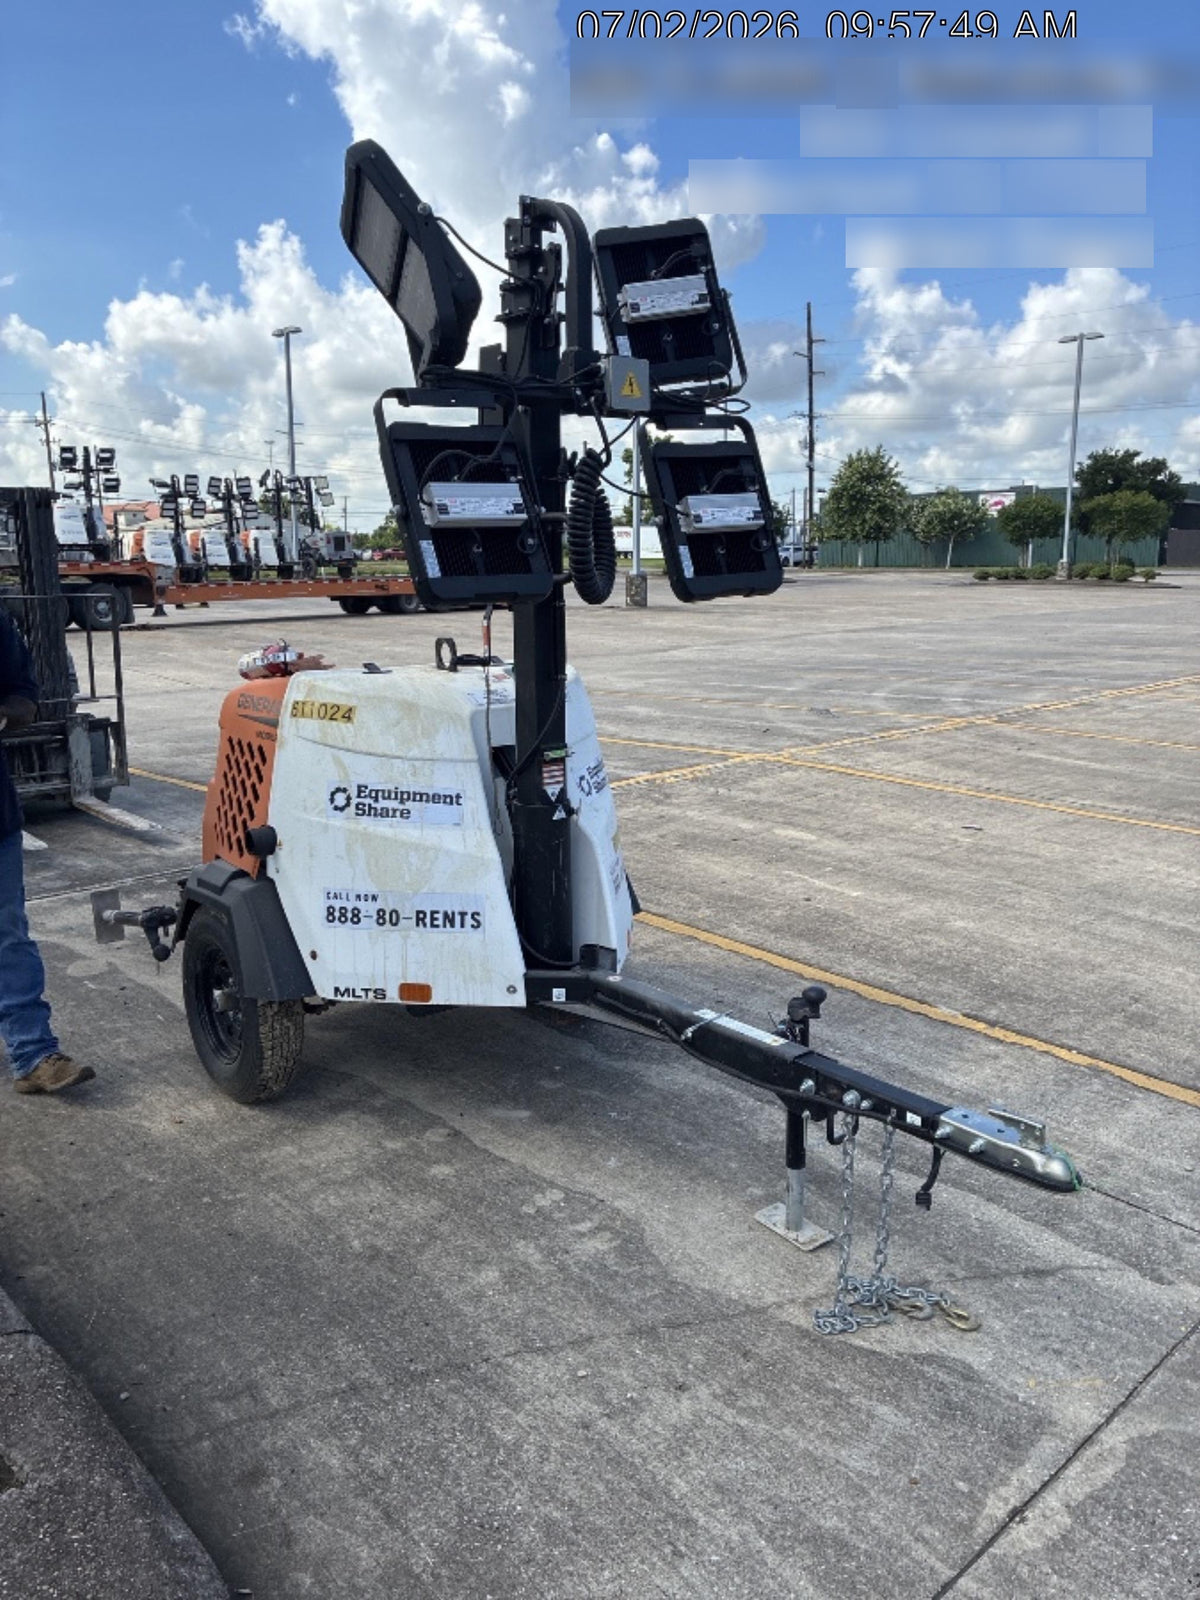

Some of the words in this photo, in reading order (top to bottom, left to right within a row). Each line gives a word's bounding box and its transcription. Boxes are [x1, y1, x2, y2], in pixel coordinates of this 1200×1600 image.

[356, 784, 462, 806] Equipment
[354, 802, 411, 819] Share
[326, 891, 350, 901] CALL
[355, 893, 379, 902] NOW
[326, 905, 482, 929] 888-80-RENTS
[333, 986, 387, 999] MLTS
